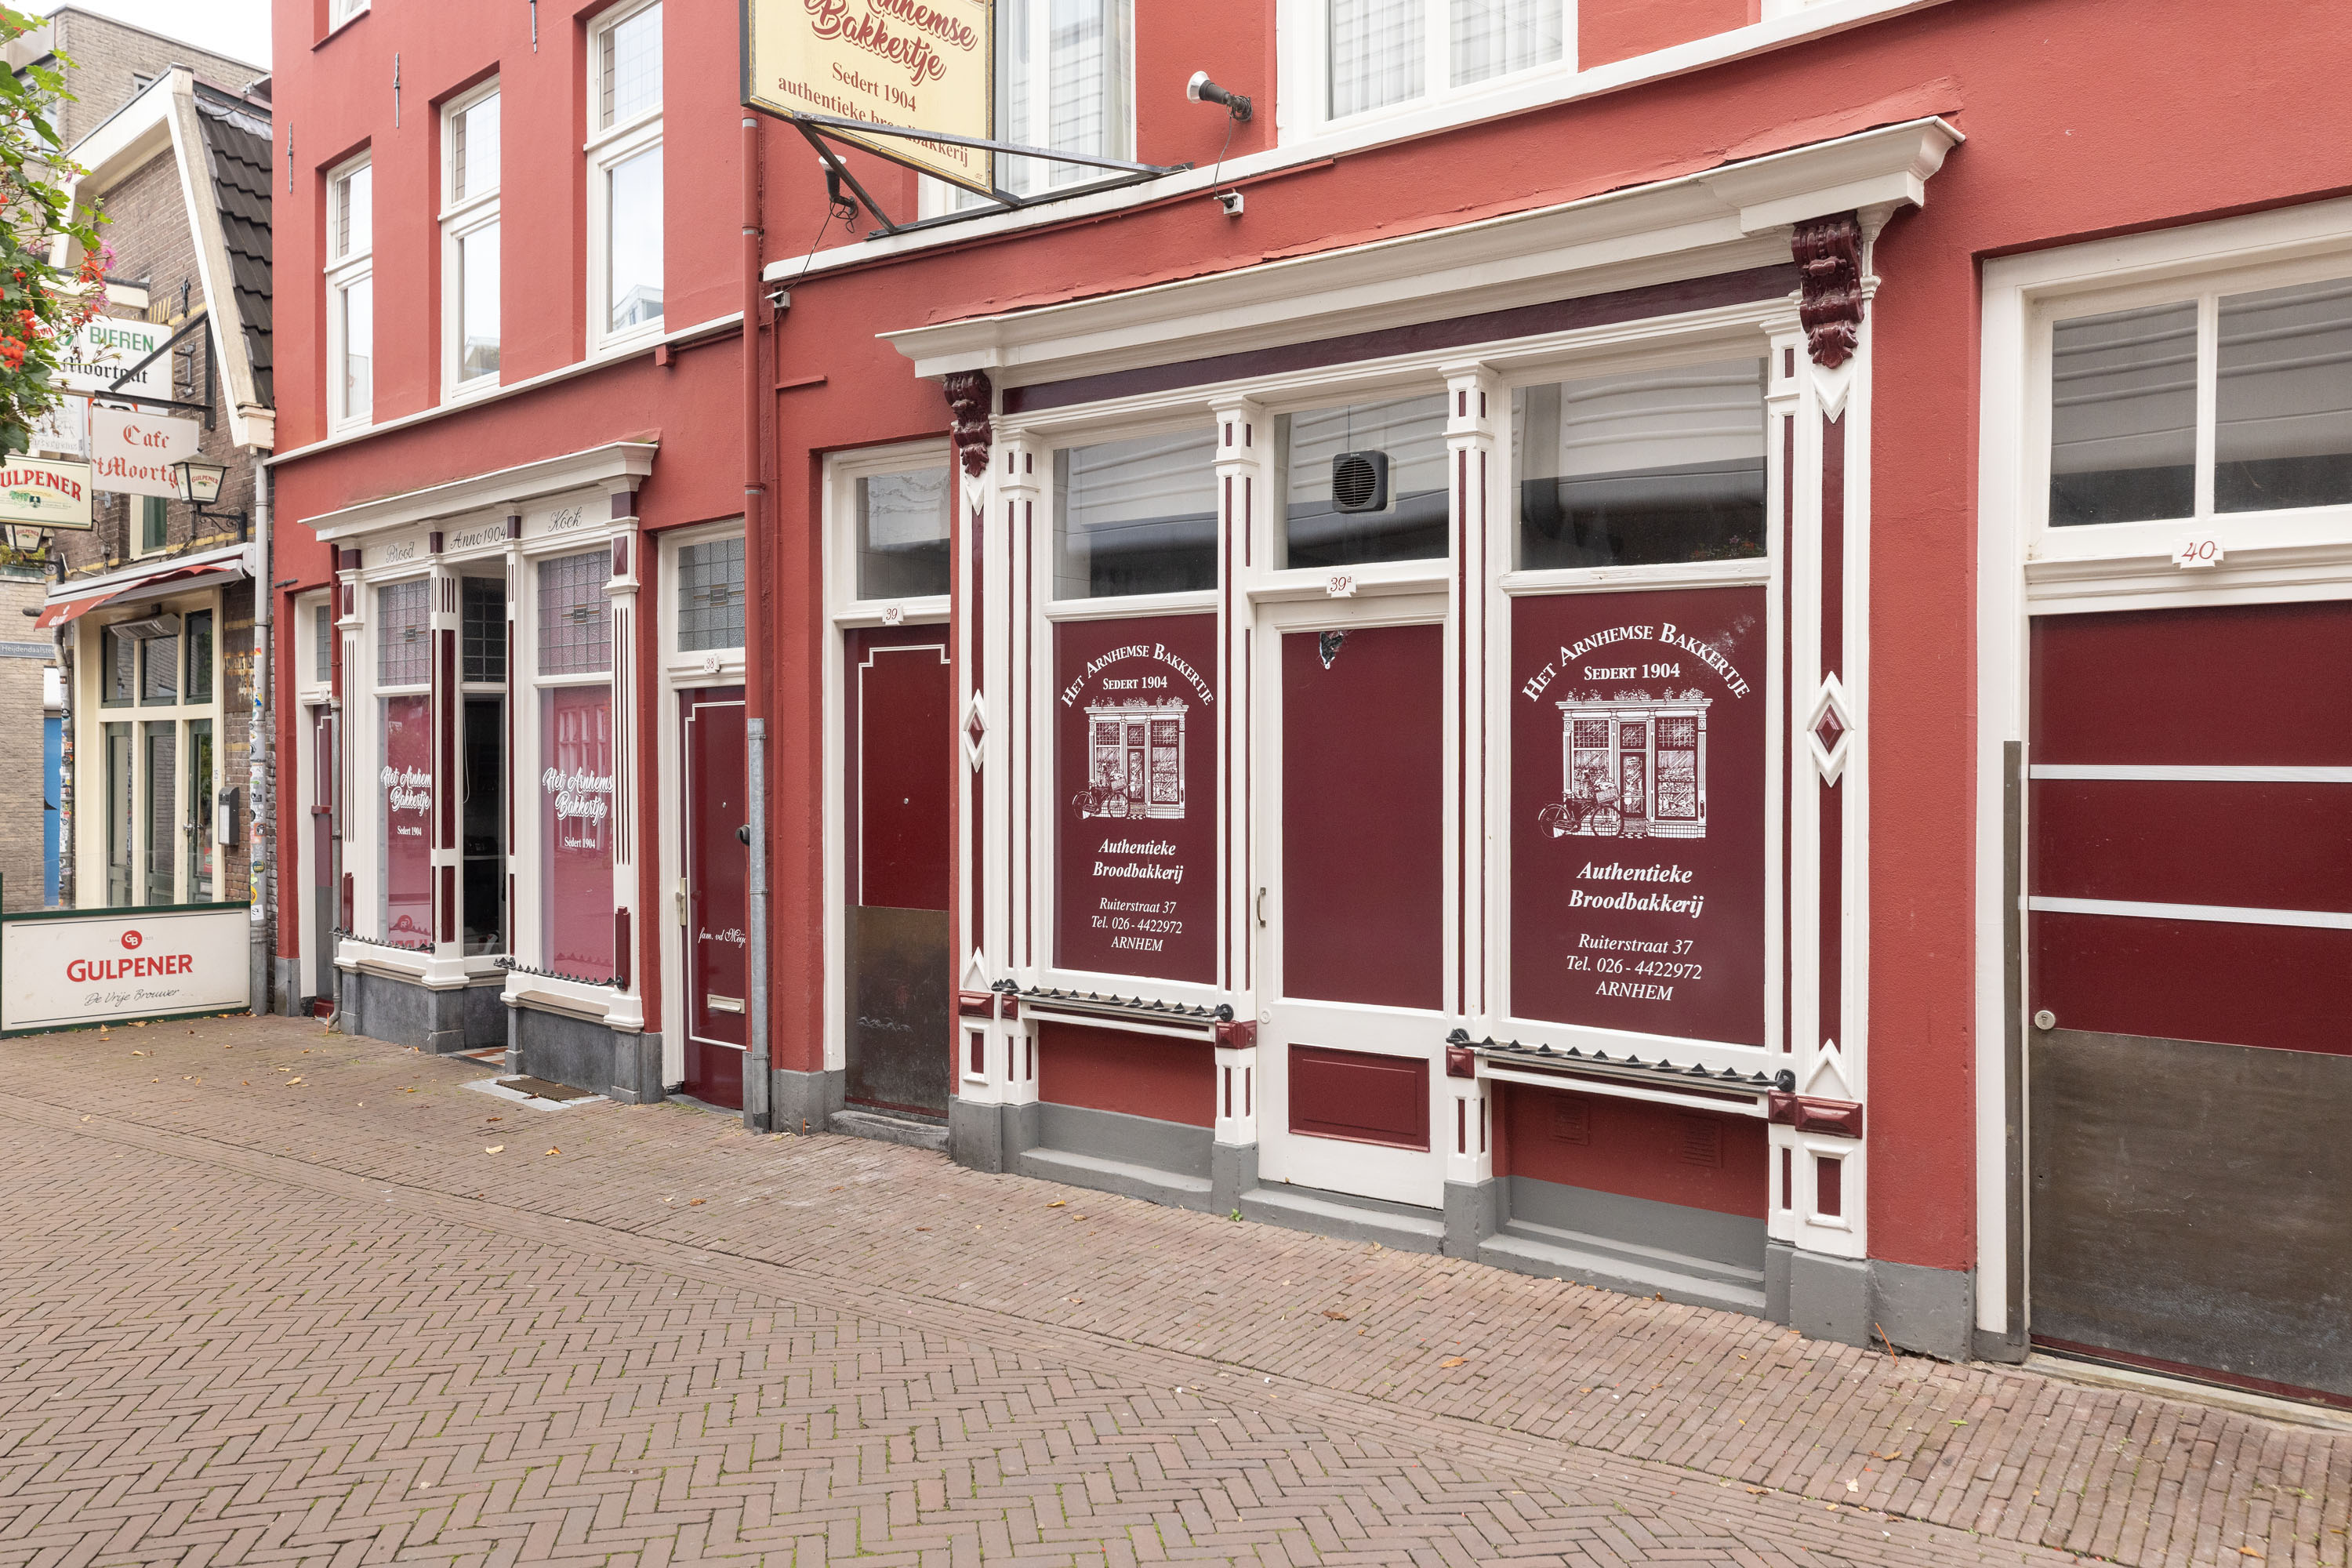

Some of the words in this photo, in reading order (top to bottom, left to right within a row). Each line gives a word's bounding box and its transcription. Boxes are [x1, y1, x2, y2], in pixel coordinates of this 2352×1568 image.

[804, 0, 946, 86] Bakkertje
[832, 62, 879, 97] Sedert
[884, 85, 916, 112] 1904
[779, 78, 866, 122] authentieke
[89, 325, 154, 353] BIEREN
[103, 456, 178, 489] Moortg
[191, 474, 219, 485] GULPENER
[0, 469, 82, 502] ULPENER
[450, 531, 483, 550] Anno
[483, 526, 507, 544] 1904
[386, 541, 415, 564] Brood
[2181, 540, 2218, 562] 40
[886, 608, 898, 621] 39
[2, 645, 56, 655] Heijdendaalstee
[706, 658, 715, 670] 38
[1522, 662, 1557, 702] HET
[1559, 625, 1653, 667] ARNHEMSE
[1659, 622, 1751, 699] BAKKERTJE
[1584, 666, 1637, 681] SEDERT
[1642, 663, 1681, 678] 1904
[1061, 675, 1085, 708] HET
[1087, 644, 1150, 679] ARNHEMSE
[1152, 643, 1214, 706] BAKKERTJE
[1102, 677, 1138, 690] SEDERT
[1142, 676, 1167, 688] 1904
[380, 765, 400, 789] Het
[543, 767, 567, 794] Het
[567, 766, 613, 796] Arnhems
[390, 786, 431, 817] Bakkertje
[554, 791, 608, 826] Bakkertje
[397, 825, 411, 836] Sedert
[412, 826, 422, 837] 1904
[564, 836, 582, 848] Sedert
[583, 837, 596, 849] 1904
[1098, 838, 1176, 856] Authentieke
[1092, 861, 1184, 884] Broodbakkerij
[1576, 862, 1693, 884] Authentieke
[1099, 897, 1160, 913] Ruiterstraat
[1162, 902, 1177, 914] 37
[1568, 889, 1704, 919] Broodbakkerij
[1091, 916, 1109, 928] Tel.
[125, 934, 139, 946] GB
[698, 927, 713, 943] fam.
[715, 929, 725, 941] vd
[1111, 936, 1164, 952] ARNHEM
[1578, 933, 1669, 954] Ruiterstraat
[1672, 939, 1693, 955] 37
[67, 953, 193, 983] GULPENER
[1566, 955, 1592, 971] Tel.
[84, 992, 102, 1007] De
[104, 991, 131, 1007] Vrije
[133, 989, 180, 1001] Brouwer
[1595, 981, 1674, 1001] ARNHEM
